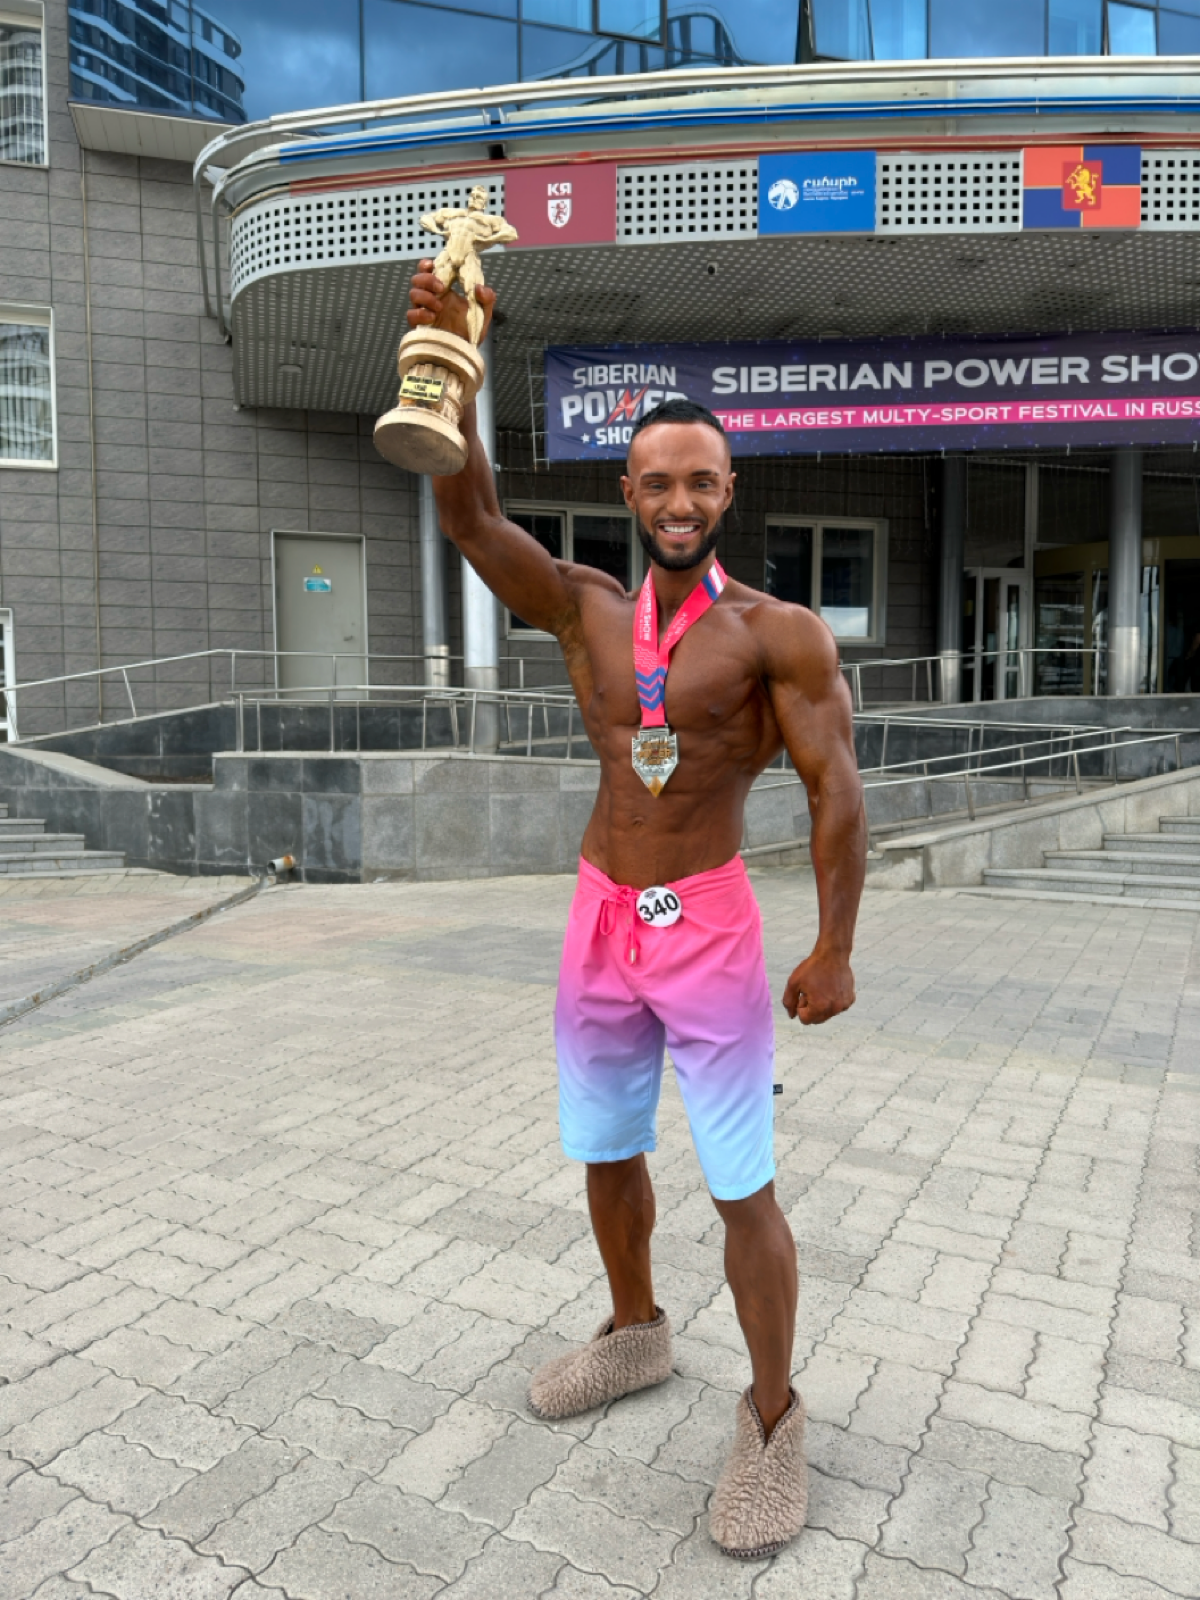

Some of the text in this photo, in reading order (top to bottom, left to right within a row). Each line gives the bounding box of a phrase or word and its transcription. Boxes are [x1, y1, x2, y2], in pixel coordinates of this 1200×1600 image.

[573, 363, 677, 389] SIBERIAN
[712, 352, 1200, 394] SIBERIAN POWER SHO
[715, 414, 754, 428] THE
[761, 410, 857, 426] LARGEST
[863, 406, 1012, 424] MULTY-SPORT
[1019, 402, 1118, 419] FESTIVAL
[1125, 402, 1144, 417] IN
[595, 426, 634, 445] SHO
[639, 892, 679, 923] 340
